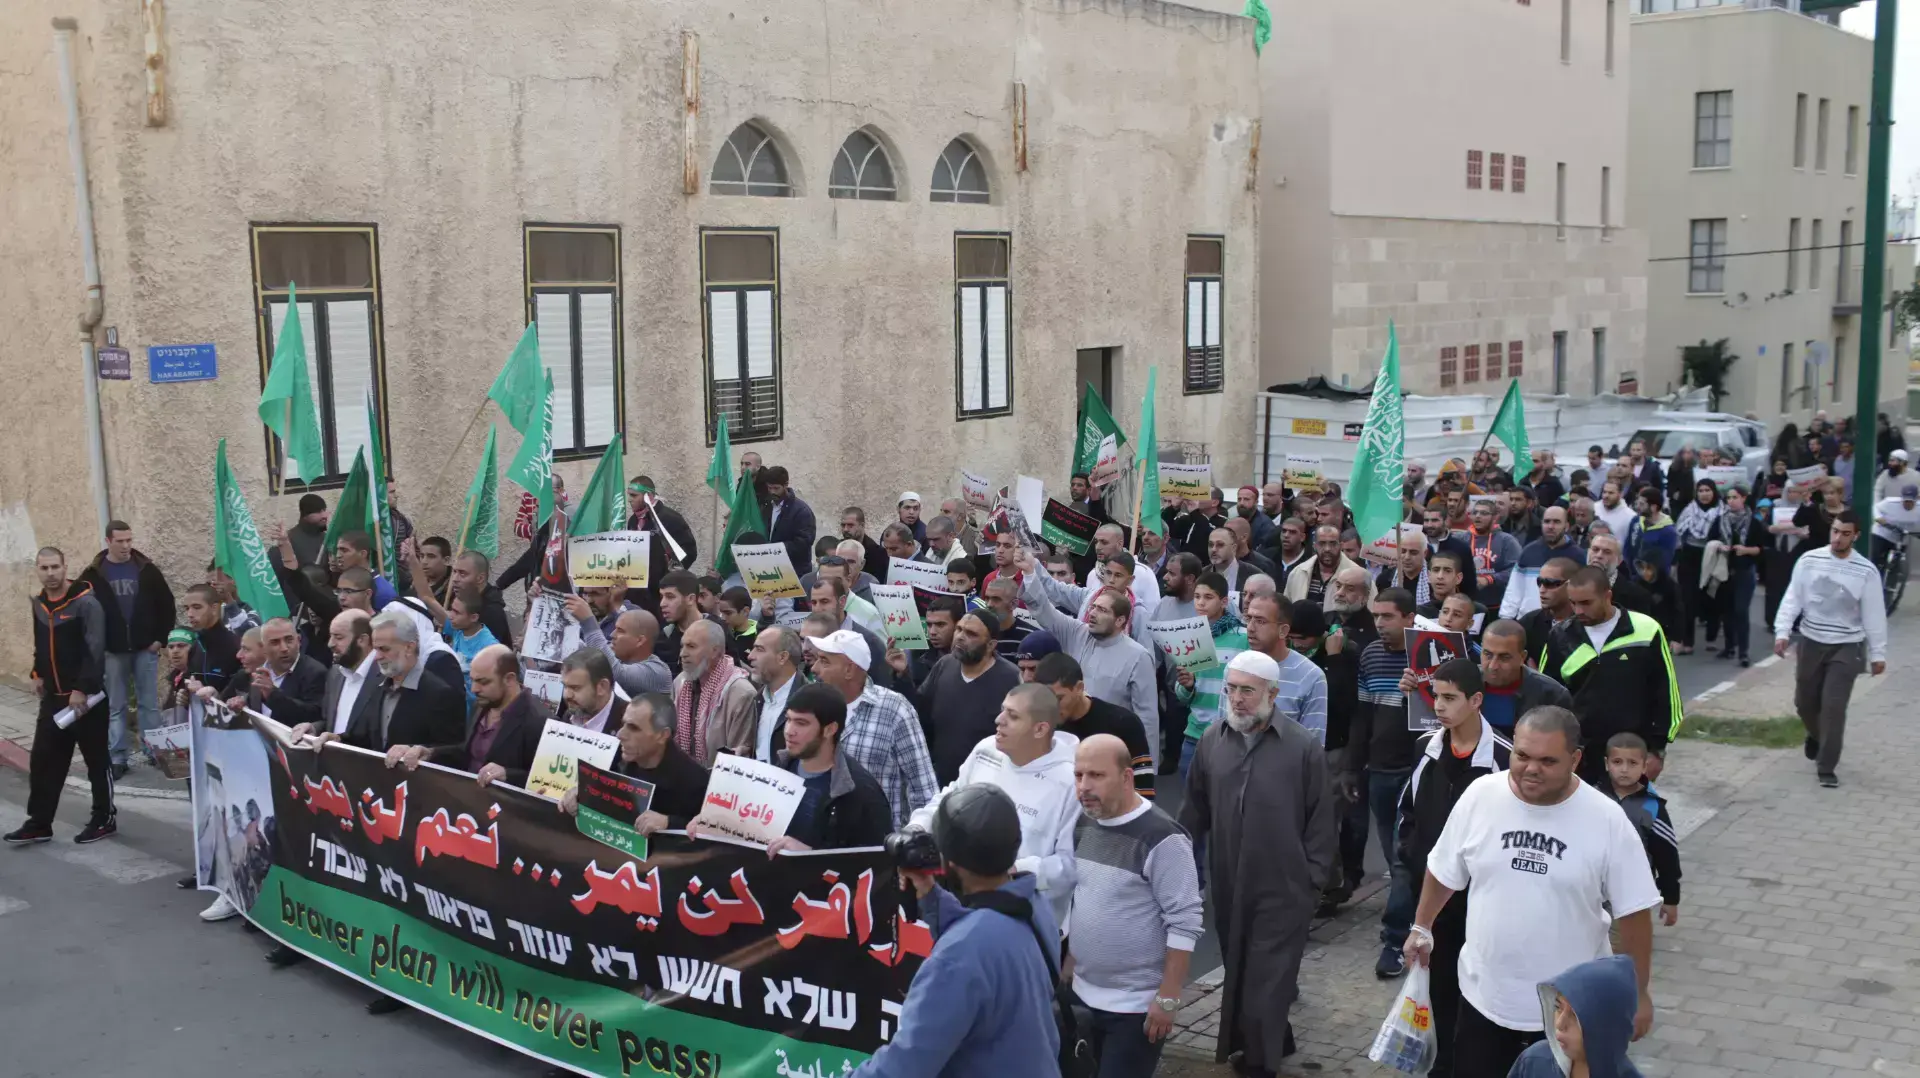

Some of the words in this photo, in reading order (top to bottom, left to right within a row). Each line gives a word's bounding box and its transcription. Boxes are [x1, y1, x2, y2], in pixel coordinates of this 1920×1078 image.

[106, 328, 117, 344] 10
[1168, 476, 1200, 490] البحيرة
[587, 553, 613, 570] رتال
[616, 549, 631, 571] أم
[748, 566, 784, 584] البحيرة
[358, 780, 408, 845] لن
[705, 790, 739, 811] النعم
[738, 801, 775, 827] وادي
[415, 803, 502, 869] نعم
[1500, 830, 1567, 861] TOMMY
[1517, 849, 1526, 858] 19
[376, 863, 408, 903] לא
[1512, 859, 1547, 874] JEANS
[413, 881, 497, 941] פראוור
[677, 866, 765, 936] لن
[776, 867, 936, 968] رافر
[278, 880, 364, 956] braver
[370, 923, 437, 988] plan
[448, 960, 505, 1014] will
[512, 988, 603, 1053] never
[587, 942, 639, 981] לא
[656, 955, 743, 1009] תעשו
[762, 976, 858, 1031] שלא
[880, 998, 904, 1042] ה
